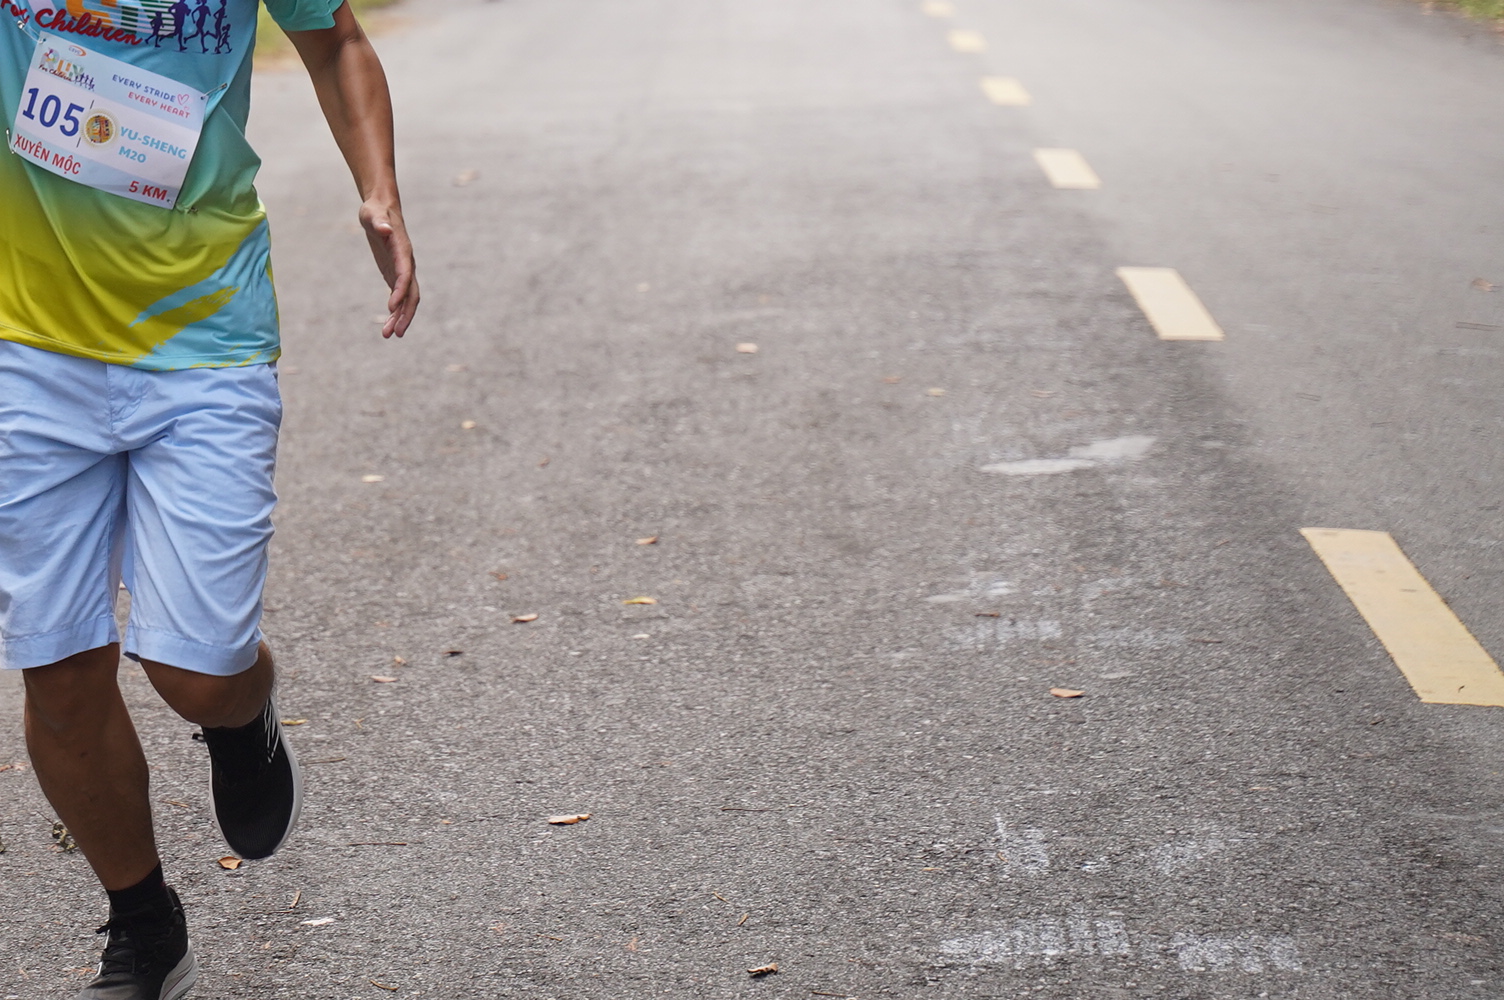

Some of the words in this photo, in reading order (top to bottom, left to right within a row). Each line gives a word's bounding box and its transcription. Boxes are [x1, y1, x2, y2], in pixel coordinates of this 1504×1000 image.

[34, 8, 143, 45] Children
[112, 74, 141, 89] EVERY
[144, 86, 176, 102] STRIDE
[128, 91, 157, 106] EVERY
[160, 103, 190, 118] HEART
[22, 87, 85, 137] 105
[15, 133, 50, 162] XUYÊN
[52, 154, 81, 175] MỘC
[120, 126, 187, 159] YU-SHENG
[128, 180, 139, 193] 5
[142, 184, 168, 201] KM
